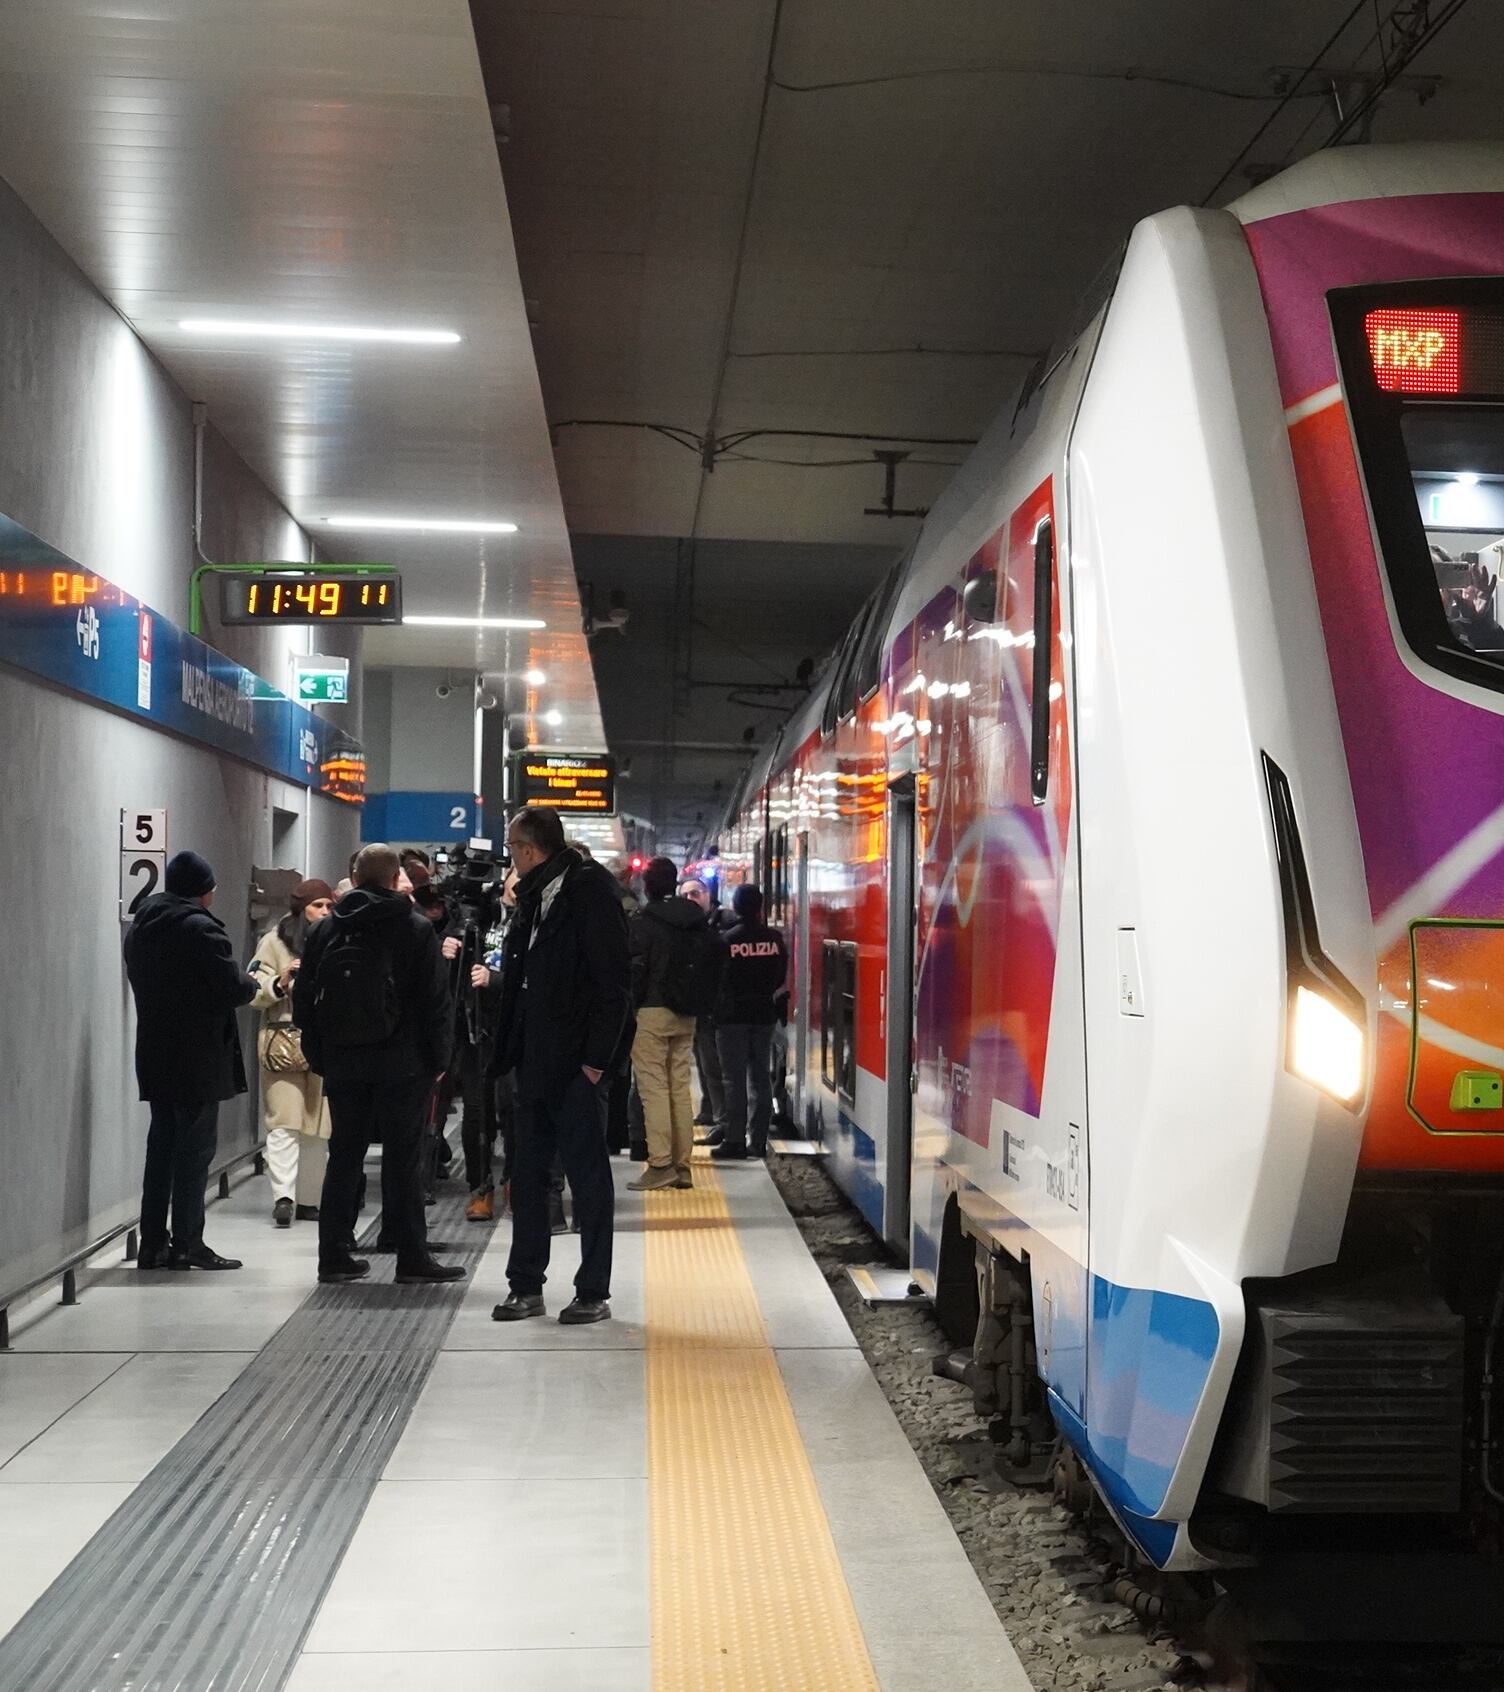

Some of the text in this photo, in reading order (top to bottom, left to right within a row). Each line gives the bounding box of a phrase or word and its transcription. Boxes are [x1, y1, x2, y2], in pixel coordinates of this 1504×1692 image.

[1373, 329, 1446, 369] MXP
[248, 583, 387, 616] 11:49 11
[546, 758, 582, 768] BINARIO
[135, 815, 153, 844] 5
[450, 806, 466, 829] 2
[127, 858, 159, 915] 2
[730, 941, 780, 958] POLIZIA
